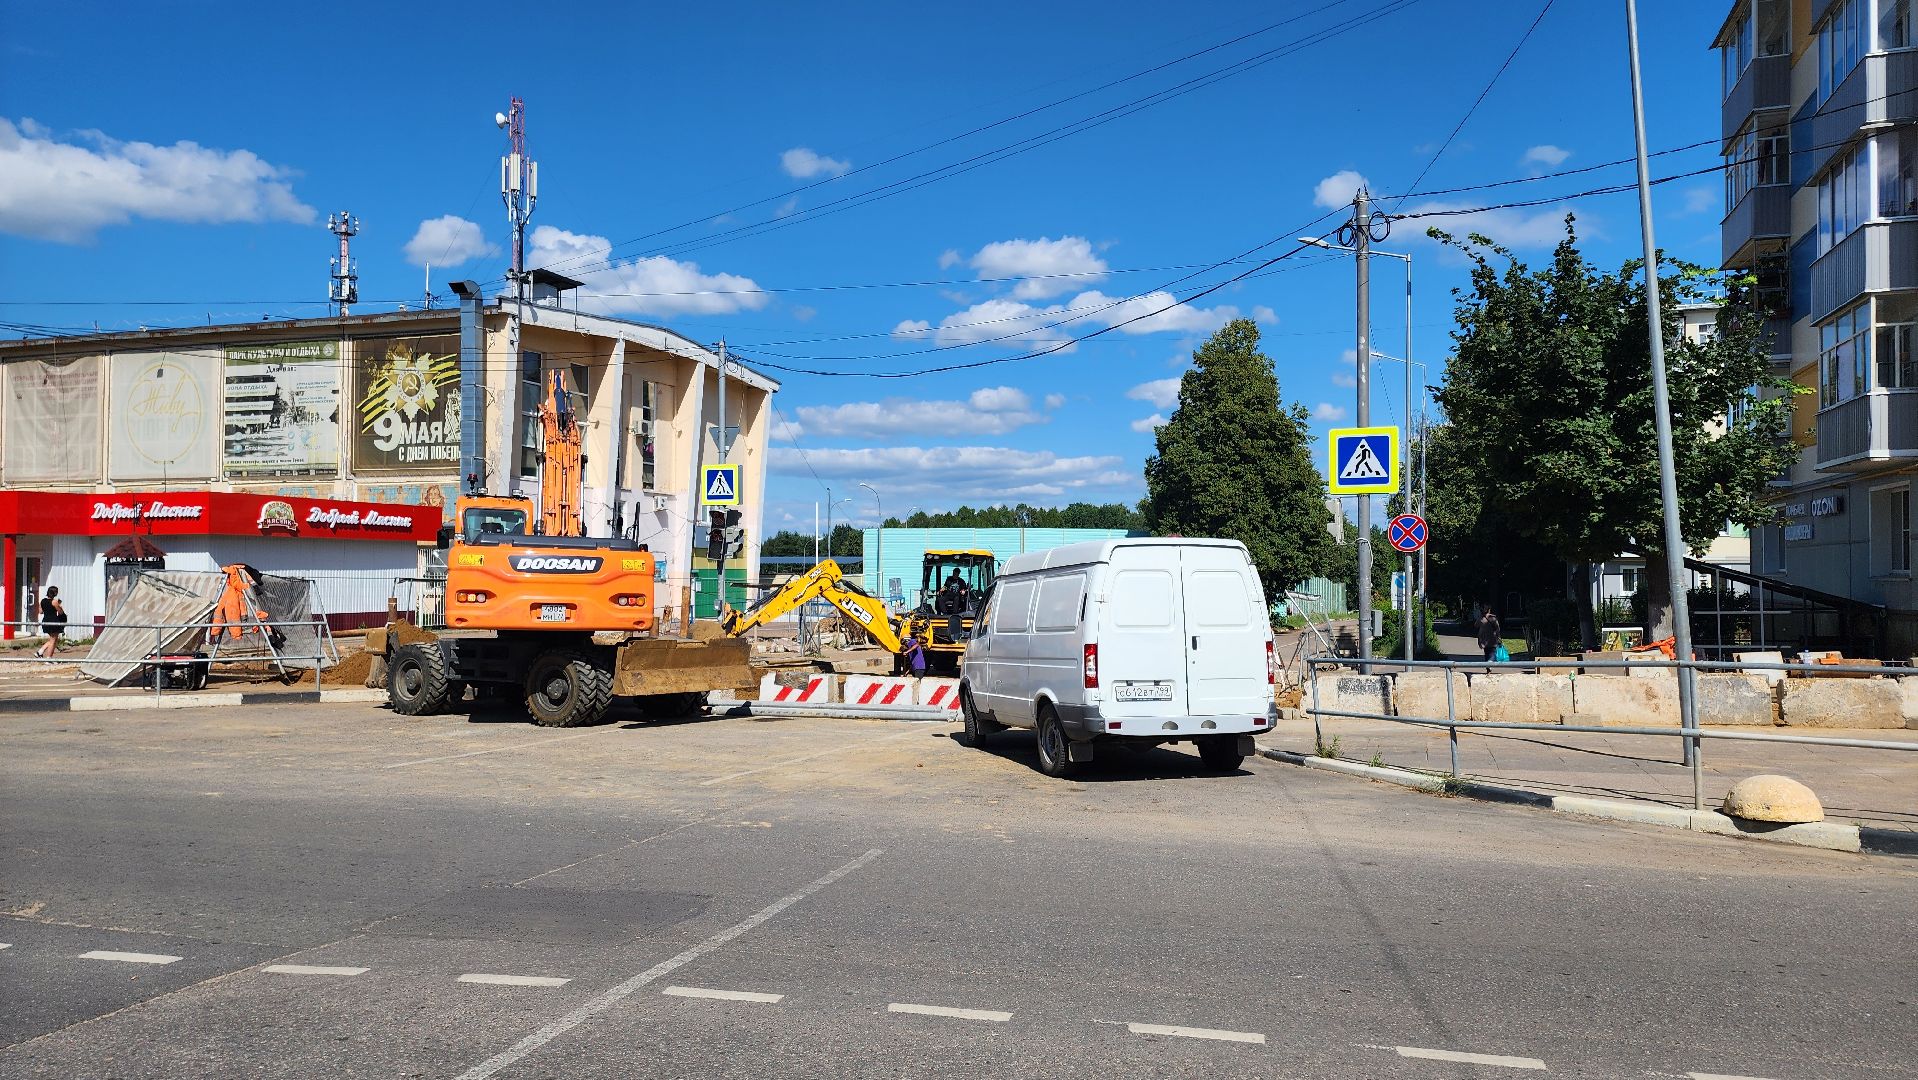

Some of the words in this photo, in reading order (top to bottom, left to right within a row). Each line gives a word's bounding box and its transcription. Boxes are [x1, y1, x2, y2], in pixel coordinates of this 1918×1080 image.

[229, 351, 247, 360] ПАРК
[247, 348, 285, 360] КУЛЬТУРЫ
[291, 346, 320, 357] ОТДЫХА
[373, 409, 401, 452] 9
[400, 421, 443, 445] МАЯ
[398, 446, 405, 462] С
[406, 446, 429, 463] ДНЕМ
[1811, 496, 1834, 517] OZON
[266, 518, 292, 526] МЯСНИК
[307, 506, 360, 529] Добрый
[361, 510, 412, 528] Мясник
[517, 558, 597, 571] DOOSAN
[841, 597, 874, 626] JCB
